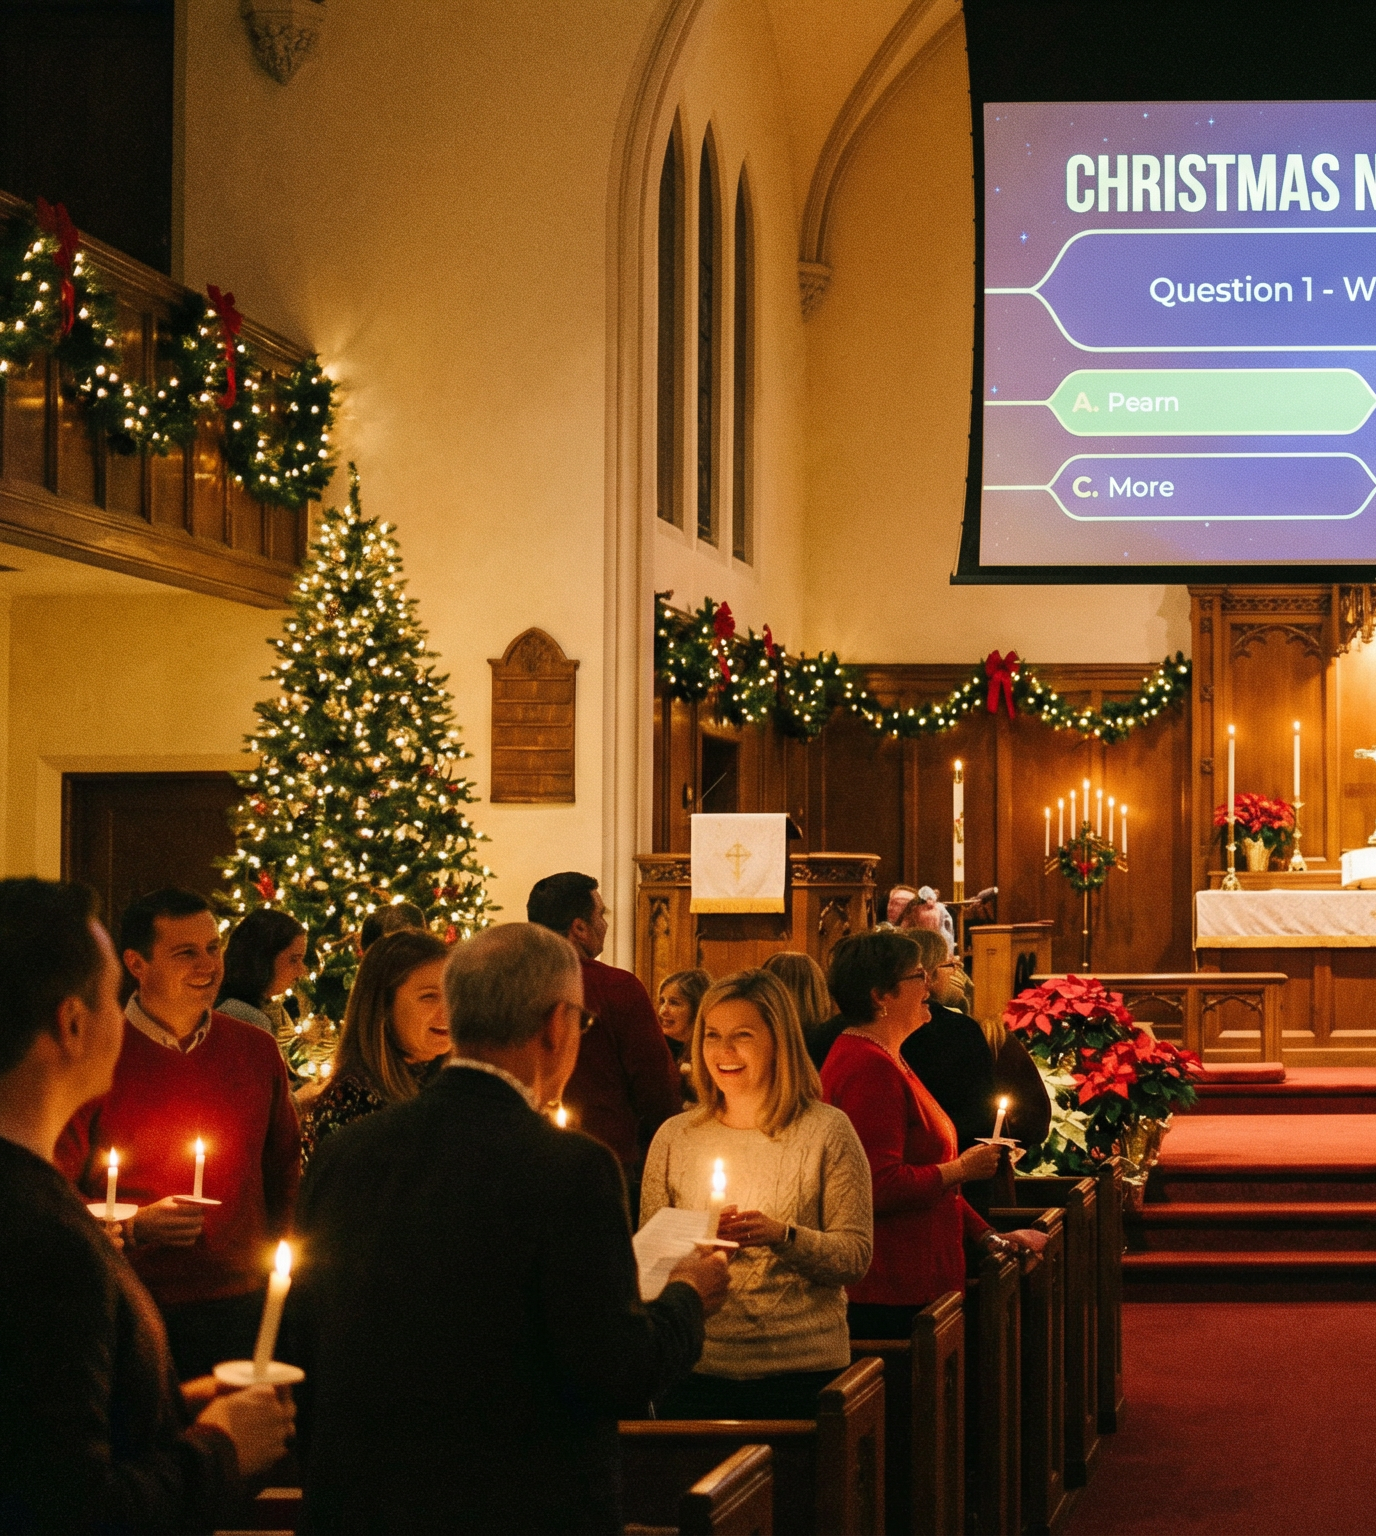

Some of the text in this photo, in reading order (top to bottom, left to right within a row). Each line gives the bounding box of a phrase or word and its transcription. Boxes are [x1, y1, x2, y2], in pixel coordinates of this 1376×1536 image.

[1066, 153, 1340, 213] CHRISTMAS
[1149, 274, 1293, 308] Question
[1301, 276, 1314, 302] 1
[1072, 392, 1100, 413] A.
[1072, 476, 1175, 498] C. More
